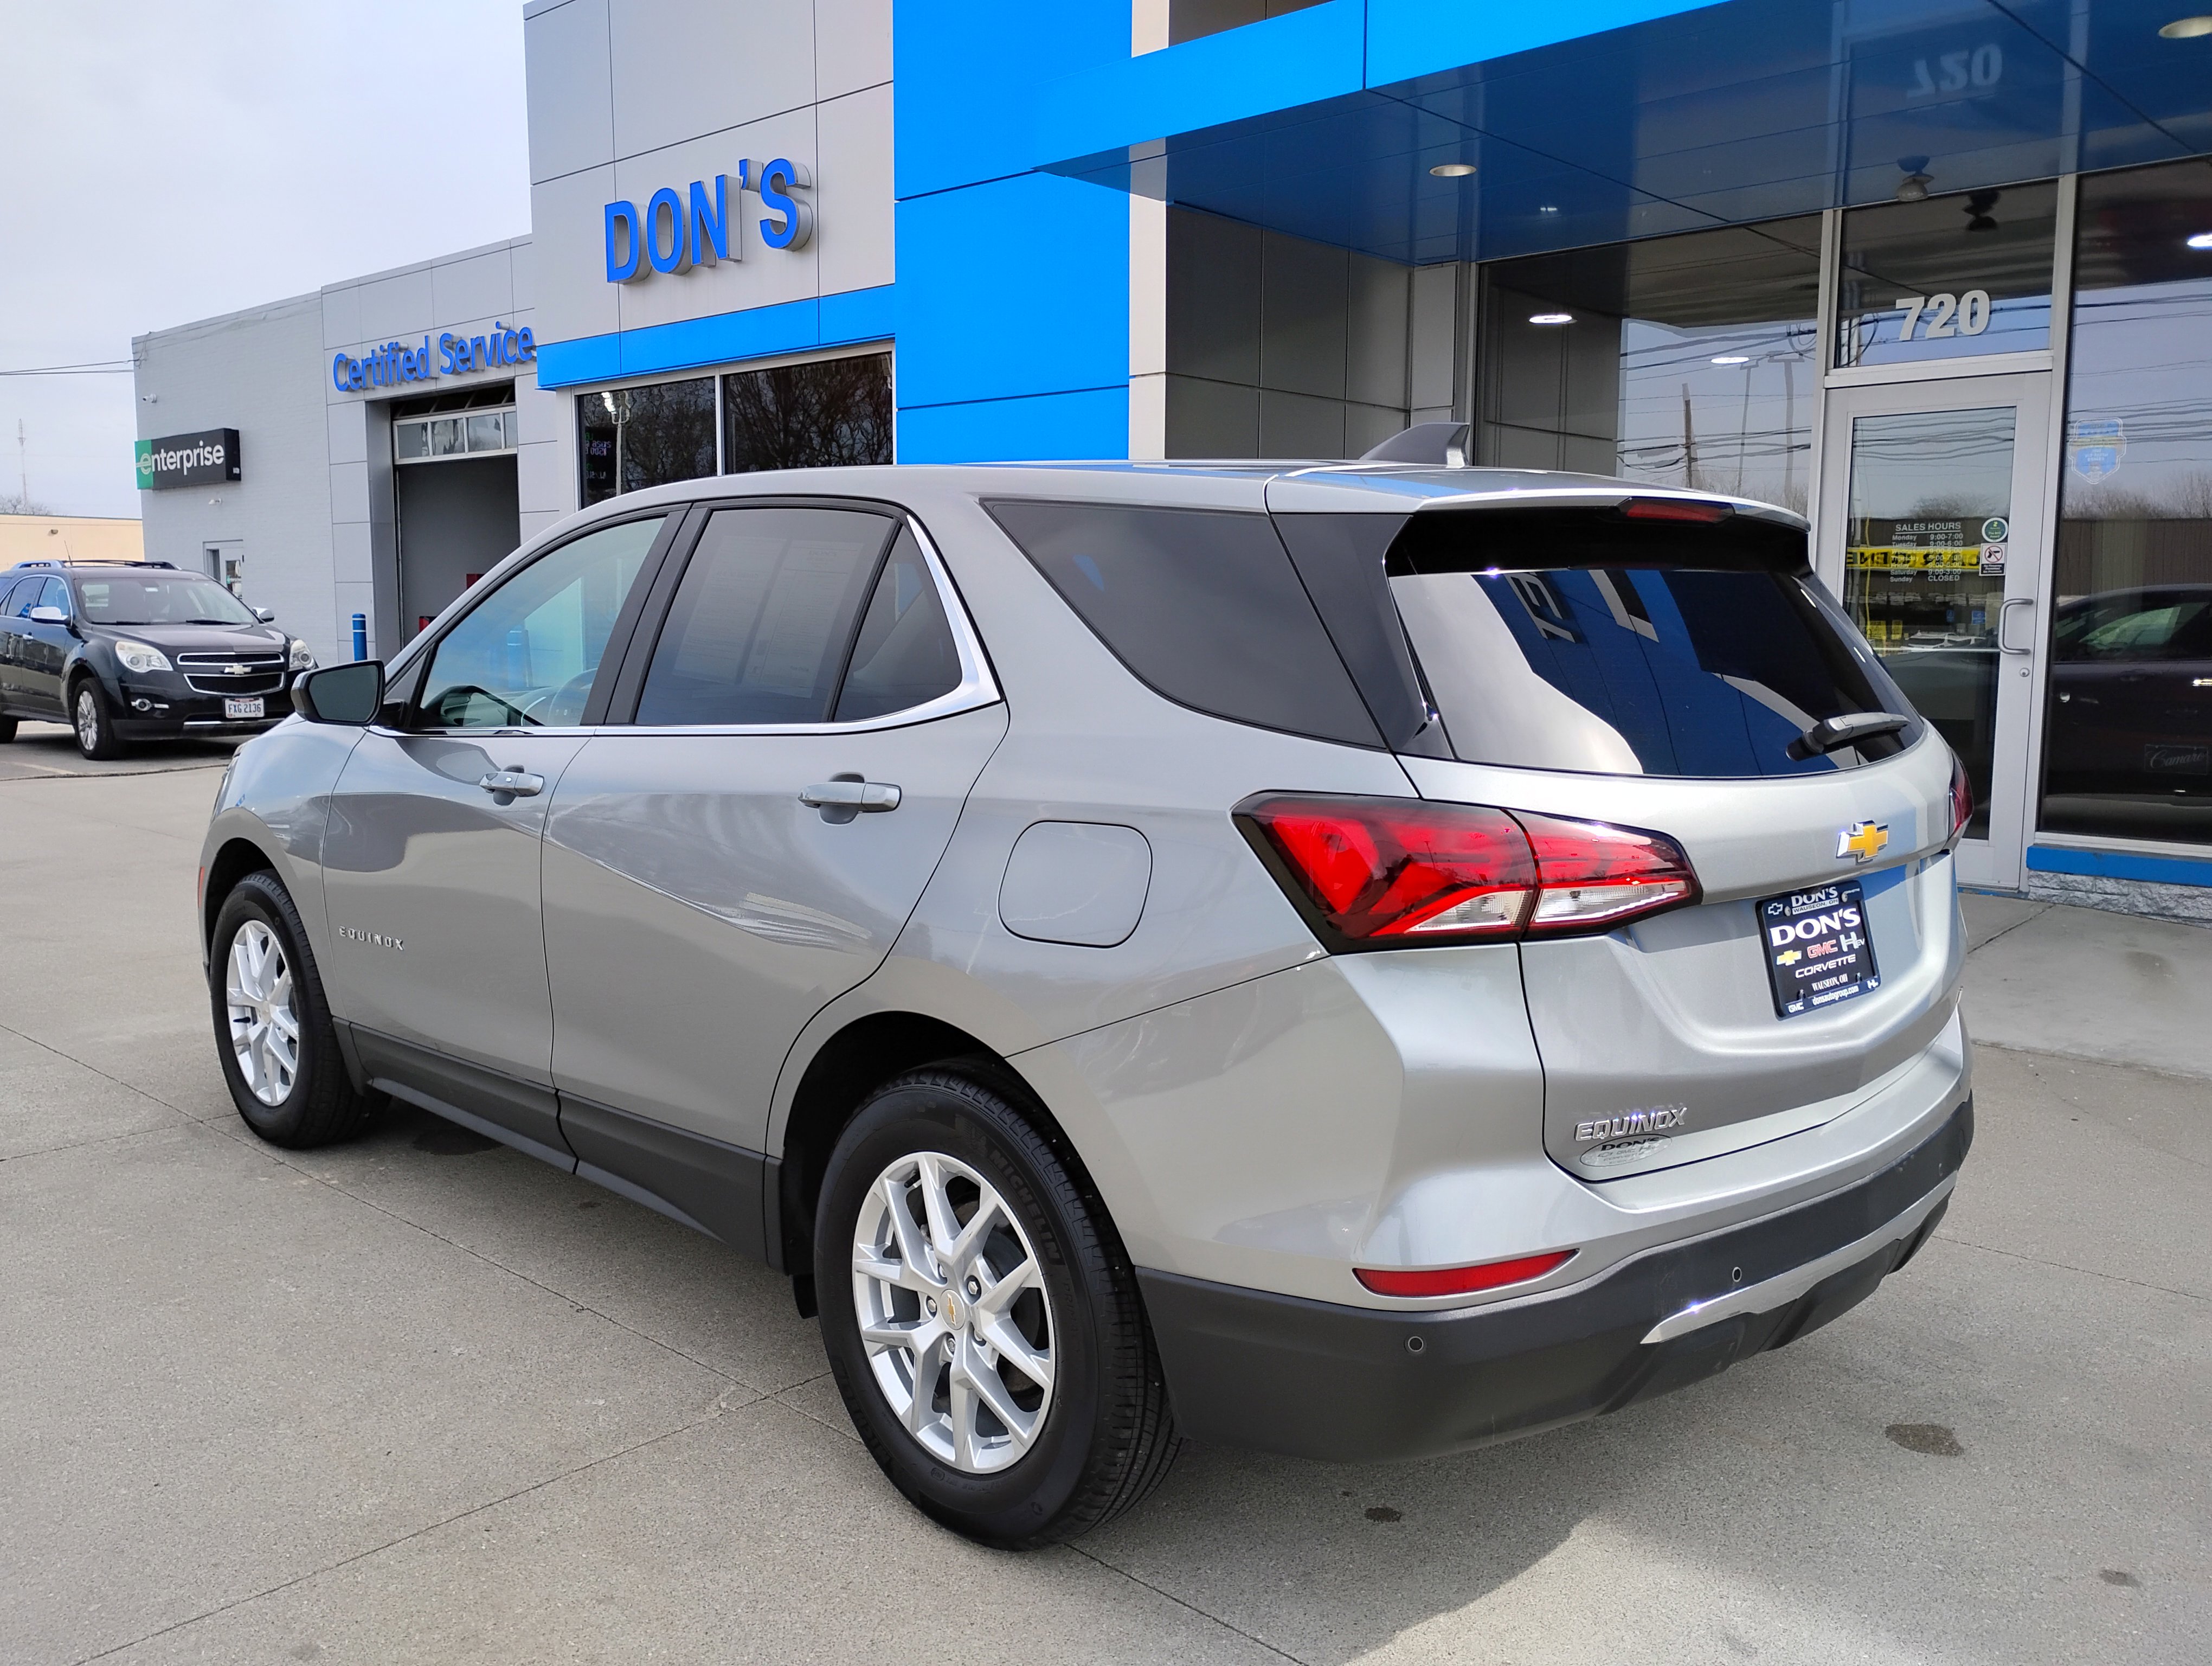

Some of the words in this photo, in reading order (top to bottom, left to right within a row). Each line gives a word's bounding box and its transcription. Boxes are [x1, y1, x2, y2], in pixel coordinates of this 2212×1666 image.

[605, 157, 806, 283] DON'S
[1896, 290, 1991, 342] 720
[333, 335, 430, 392] Certified
[439, 321, 533, 375] Service
[136, 440, 224, 475] enterprise
[1895, 523, 1925, 531] SALES
[228, 703, 242, 713] FXG
[244, 703, 261, 713] 2136
[1791, 886, 1838, 907] DON'S
[1793, 902, 1827, 913] WAUSEON,
[339, 926, 404, 950] EQUINOX
[1770, 908, 1861, 947] DON'S
[1807, 939, 1838, 959] GMC
[1795, 954, 1856, 978] CORVETTE
[1788, 1002, 1804, 1013] GMC
[1575, 1107, 1687, 1141] EQUINOX
[1601, 1137, 1659, 1151] DON'S
[989, 1149, 1062, 1261] MICHELIN
